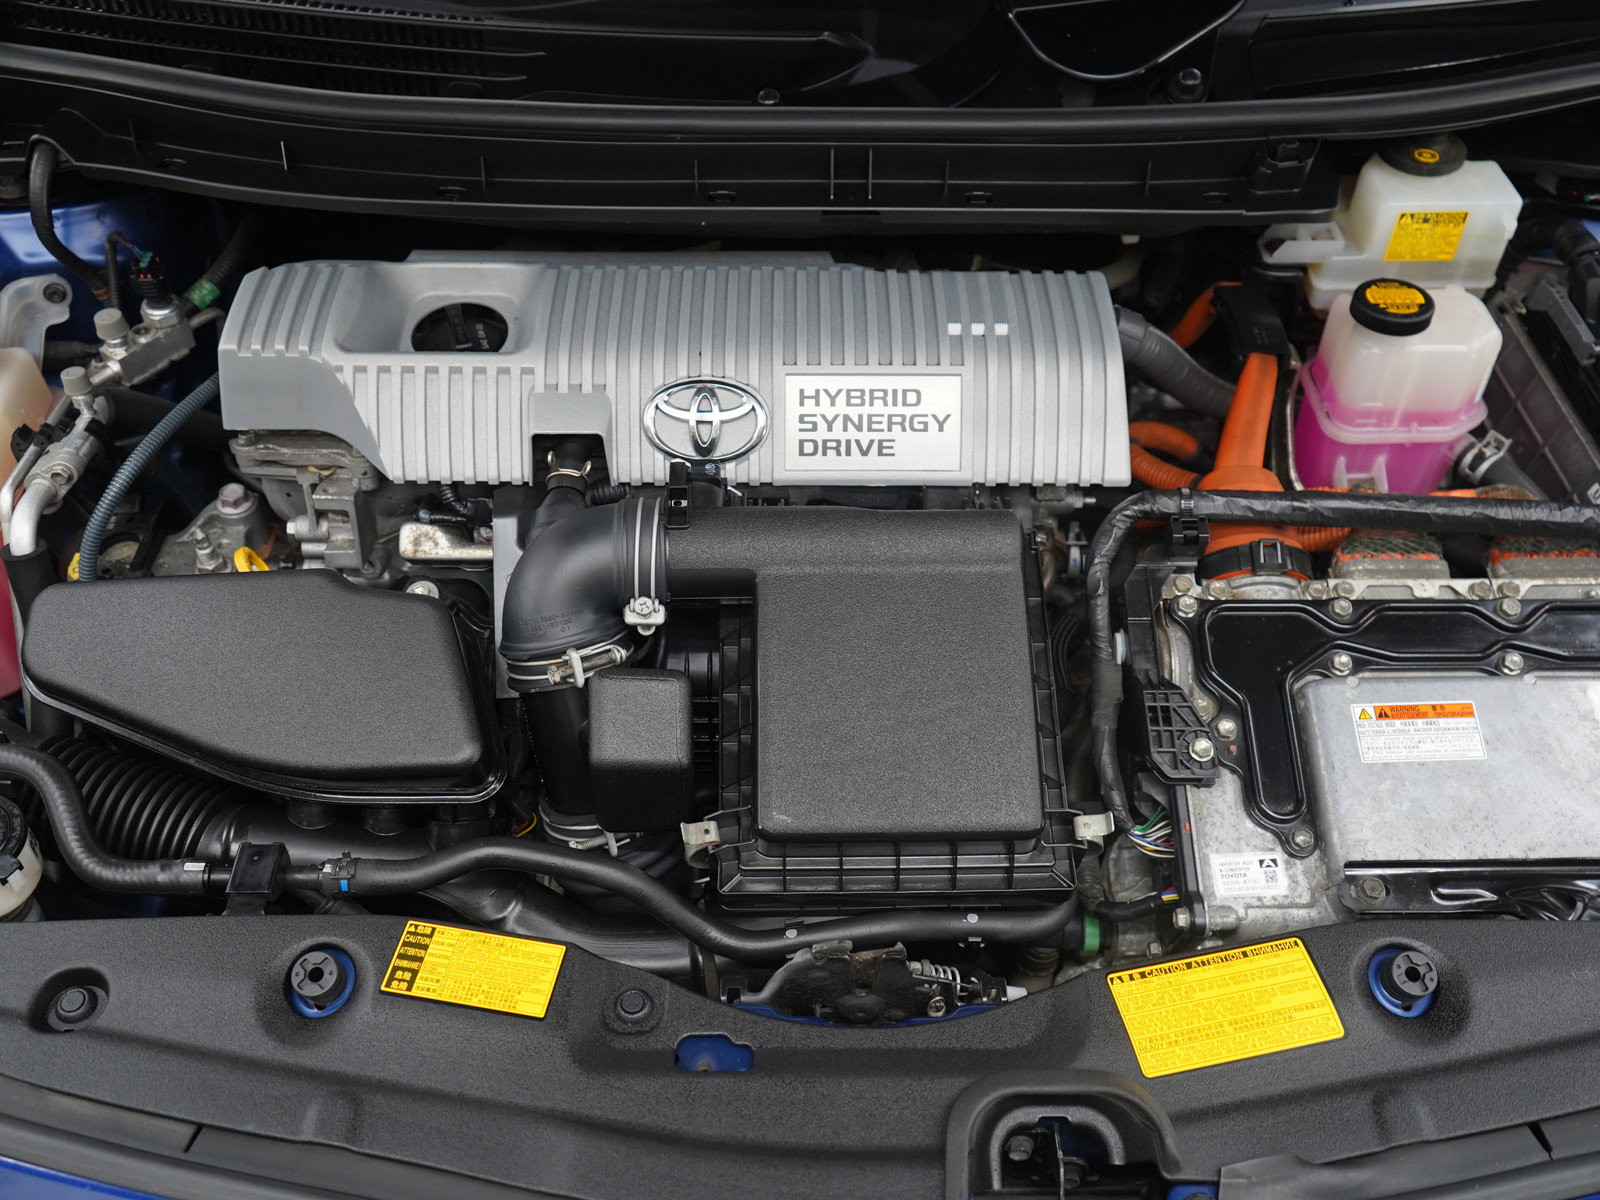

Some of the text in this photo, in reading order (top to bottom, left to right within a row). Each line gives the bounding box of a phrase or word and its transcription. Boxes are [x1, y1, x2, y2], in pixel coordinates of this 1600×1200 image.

[799, 389, 921, 407] HYBRID
[798, 413, 952, 433] SYNERGY
[798, 439, 896, 457] DRIVE
[1390, 705, 1420, 713] WARNING
[1391, 711, 1429, 719] AVERTISSEMENT
[404, 934, 432, 945] CAUTION
[399, 946, 426, 958] ATTENTION
[1246, 940, 1298, 958] ВНИМАНИЕ
[1145, 951, 1244, 978] CAUTION ATTENTION
